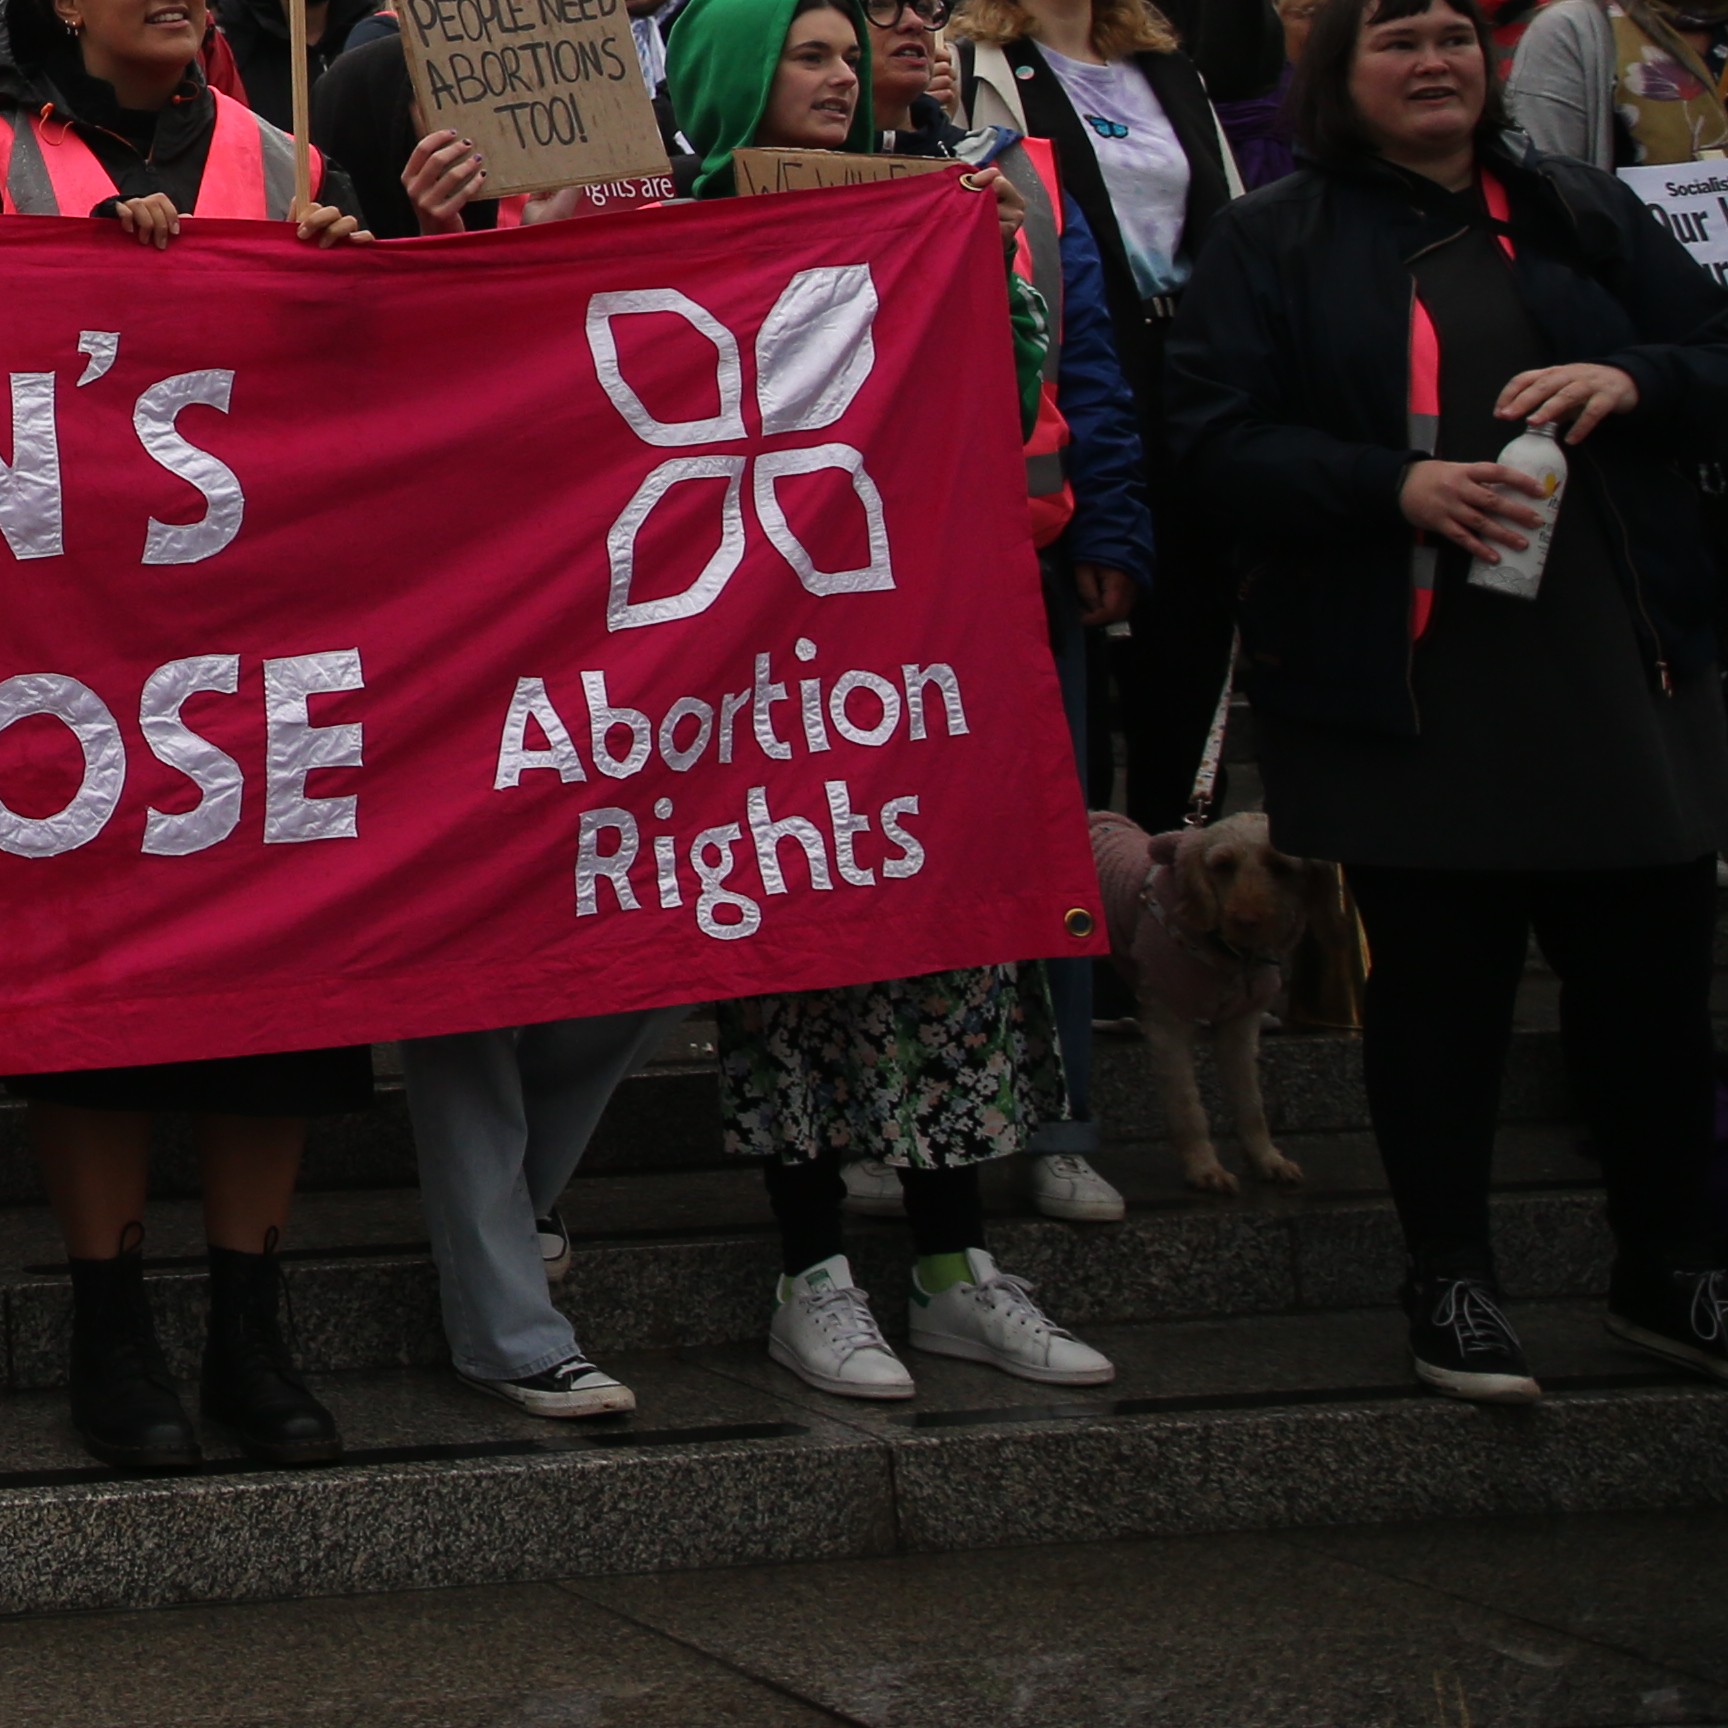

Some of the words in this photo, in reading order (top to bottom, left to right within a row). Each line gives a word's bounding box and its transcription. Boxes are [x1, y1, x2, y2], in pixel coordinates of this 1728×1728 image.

[430, 37, 627, 111] ABORTIONS
[494, 96, 588, 150] TOO!
[492, 636, 971, 791] Abortion
[574, 778, 927, 942] Rights
